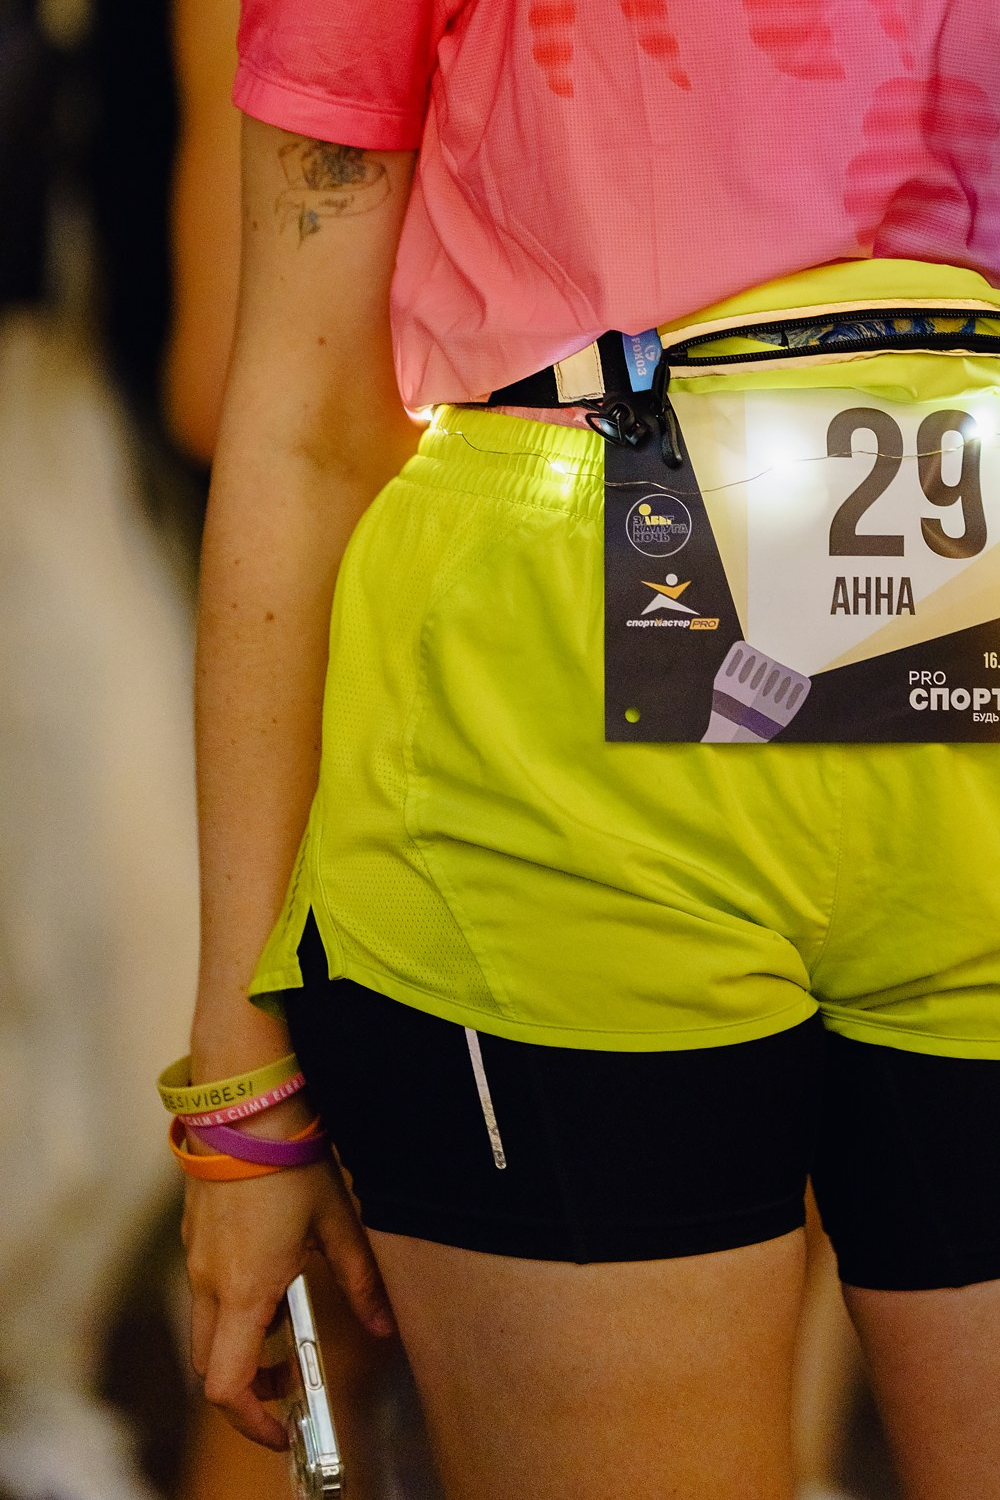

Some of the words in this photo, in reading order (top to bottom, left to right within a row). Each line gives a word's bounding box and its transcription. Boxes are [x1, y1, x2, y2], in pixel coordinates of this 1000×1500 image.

[826, 407, 988, 559] 29
[633, 532, 670, 542] НОЧЬ
[830, 576, 916, 616] АННА
[692, 620, 717, 628] PRO
[909, 671, 946, 685] PRO
[973, 712, 1000, 723] БУДЬ
[227, 1097, 270, 1120] CLIMB
